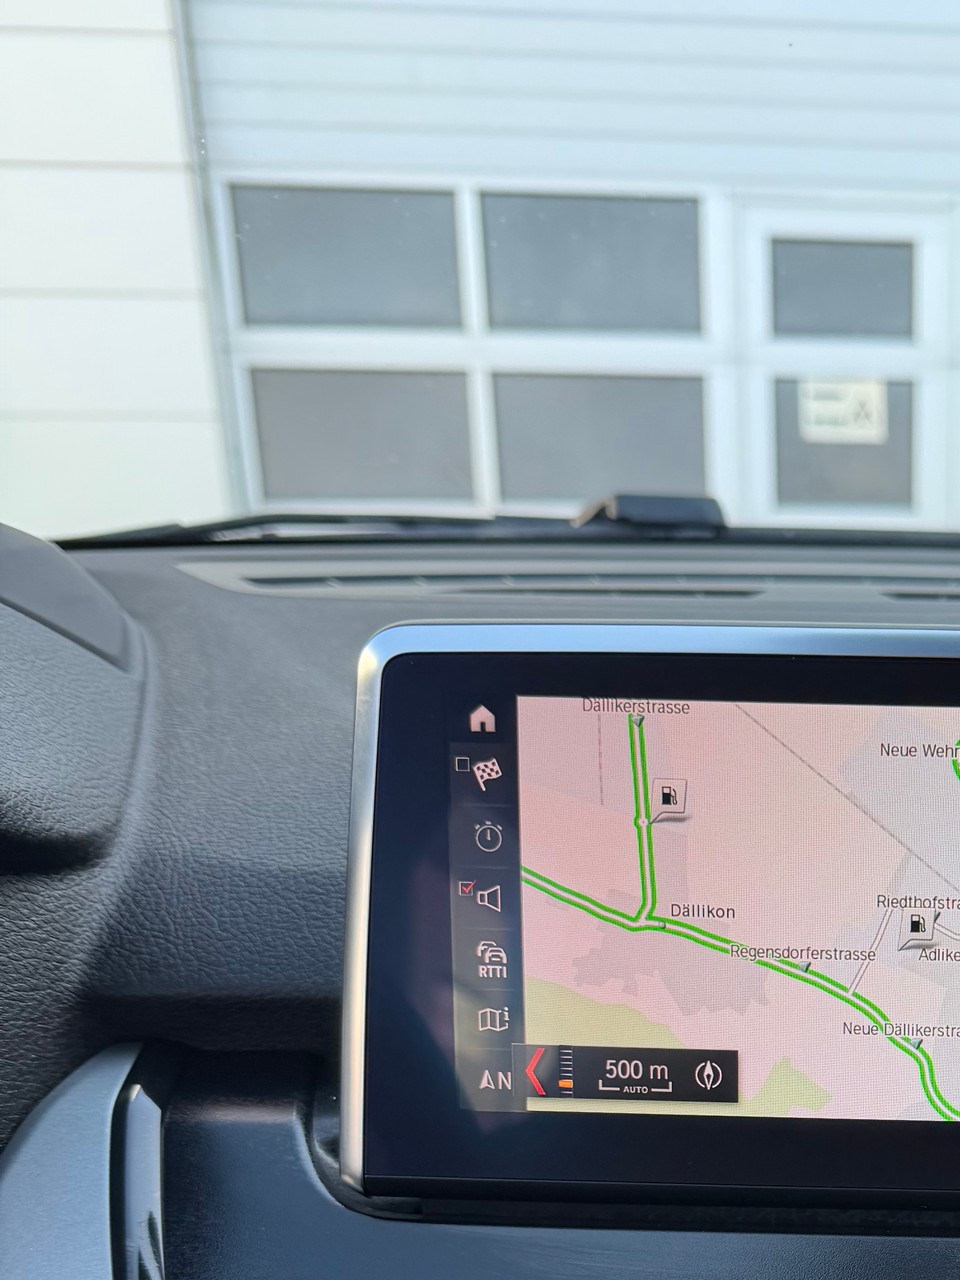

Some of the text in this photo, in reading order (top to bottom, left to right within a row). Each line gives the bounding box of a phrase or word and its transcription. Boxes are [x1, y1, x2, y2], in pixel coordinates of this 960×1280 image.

[880, 743, 917, 758] Neue
[670, 903, 736, 920] Dällikon
[730, 944, 876, 962] Regensdorferstrasse
[477, 964, 508, 979] RTTI
[842, 1022, 879, 1036] Neue
[605, 1060, 669, 1080] 500 m
[622, 1084, 649, 1095] AUTO
